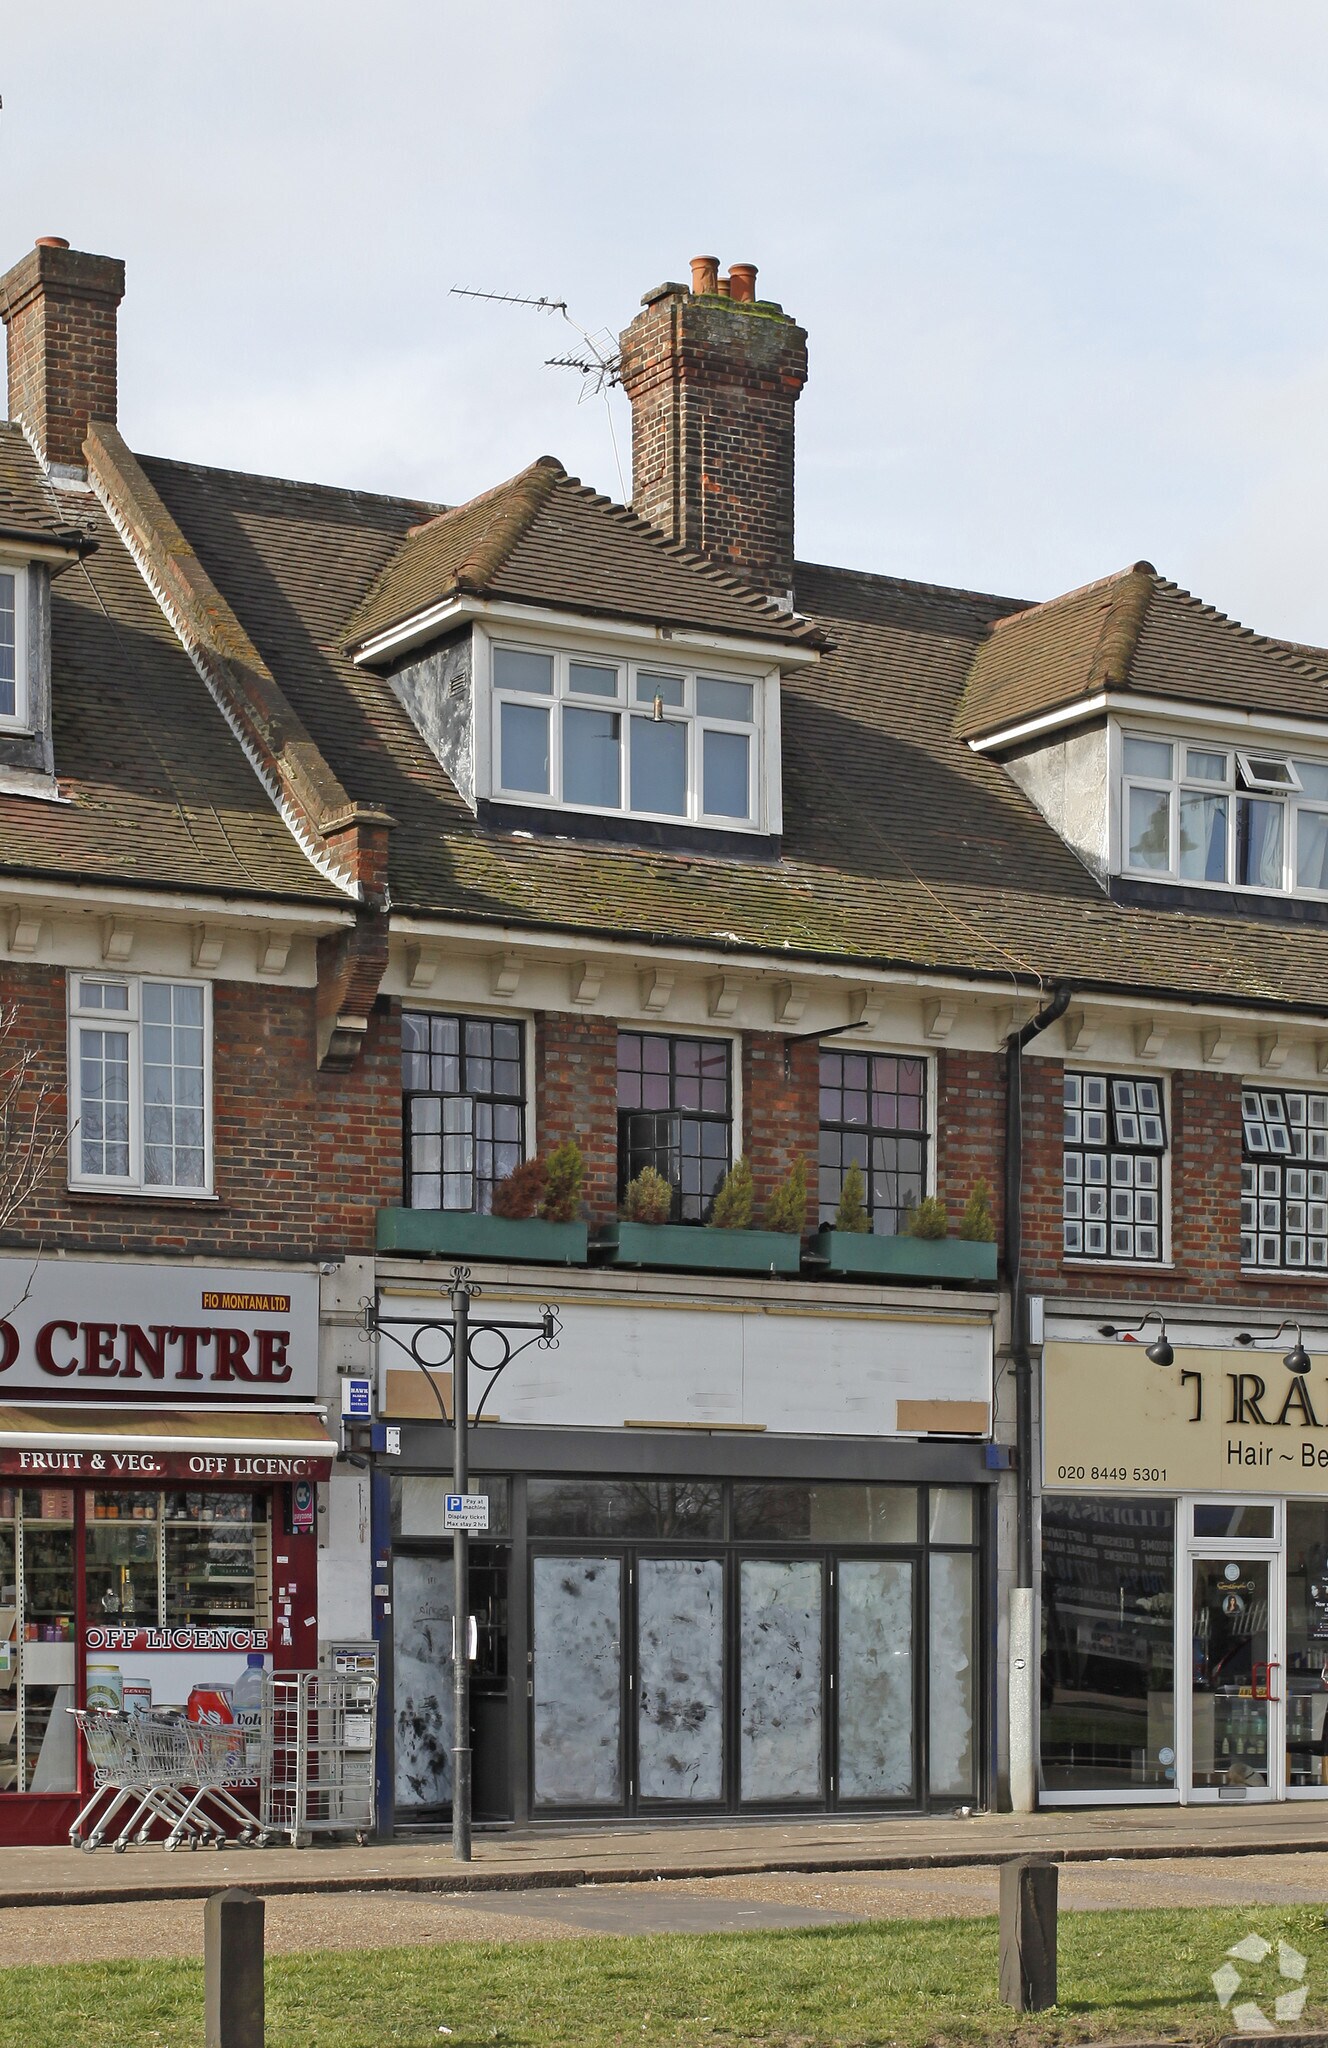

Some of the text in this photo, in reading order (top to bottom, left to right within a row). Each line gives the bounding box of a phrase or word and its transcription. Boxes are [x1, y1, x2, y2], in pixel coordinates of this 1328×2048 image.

[204, 1293, 289, 1311] FIO MONTANA LTD.
[35, 1319, 294, 1383] CENTRE
[1181, 1369, 1328, 1428] TRA
[19, 1452, 161, 1471] FRUIT & VEG.
[1227, 1440, 1273, 1466] Hair
[1301, 1442, 1328, 1468] Be
[188, 1456, 318, 1475] OFF LICENC
[1057, 1466, 1167, 1481] 020 8449 5301
[85, 1627, 269, 1649] OFF LICENCE
